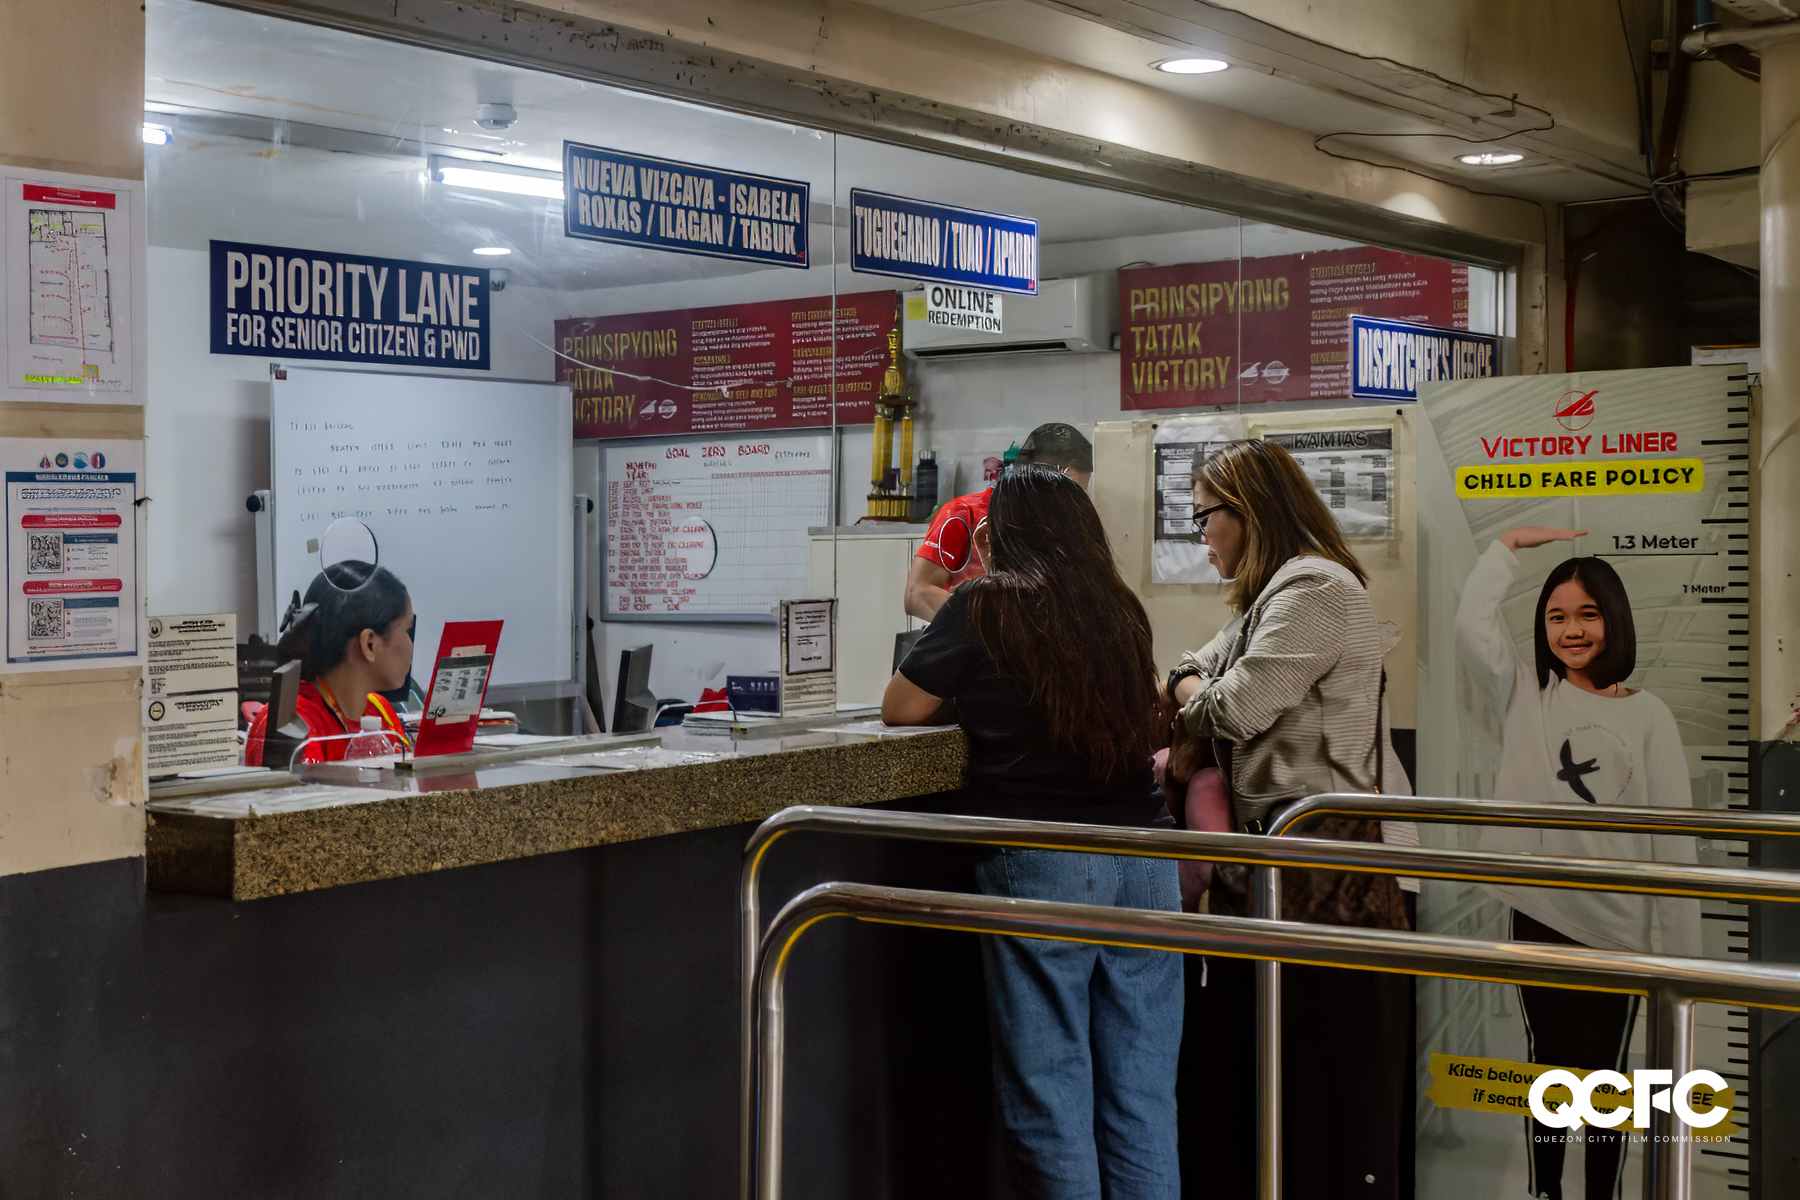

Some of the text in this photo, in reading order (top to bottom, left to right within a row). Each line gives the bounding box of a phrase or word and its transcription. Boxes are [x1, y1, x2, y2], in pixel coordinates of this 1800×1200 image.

[573, 155, 637, 198] NUEVA
[640, 167, 715, 211] VIZCAYA
[730, 182, 801, 224] ISABELA
[578, 192, 797, 255] ROXAS / ILAGAN / TABUK
[855, 206, 941, 268] TUGUEGARAO
[943, 219, 950, 269] /
[985, 226, 992, 275] /
[226, 251, 480, 329] PRIORITY LANE
[931, 286, 994, 314] ONLINE
[1131, 276, 1289, 322] PRINSIPYONG
[928, 310, 1001, 332] REDEMPTION
[226, 312, 480, 361] FOR SENIOR CITIZEN & PWD
[563, 328, 678, 362] PRINSIPYONG
[1131, 322, 1203, 358] TATAK
[1358, 327, 1450, 392] DISPATCHER'S
[1131, 355, 1231, 395] VICTORY
[575, 394, 636, 424] ICTORY
[665, 446, 690, 459] GOAL
[738, 443, 770, 456] BOARD
[1294, 431, 1369, 449] KAMIAS
[1480, 431, 1678, 459] VICTORY LINER
[1464, 467, 1695, 490] CHILD FARE POLICY
[1612, 535, 1699, 550] 1.3 Meter
[1691, 584, 1726, 594] Meter
[1448, 1063, 1483, 1079] Kids
[1487, 1067, 1539, 1085] below
[1472, 1088, 1532, 1108] if seate
